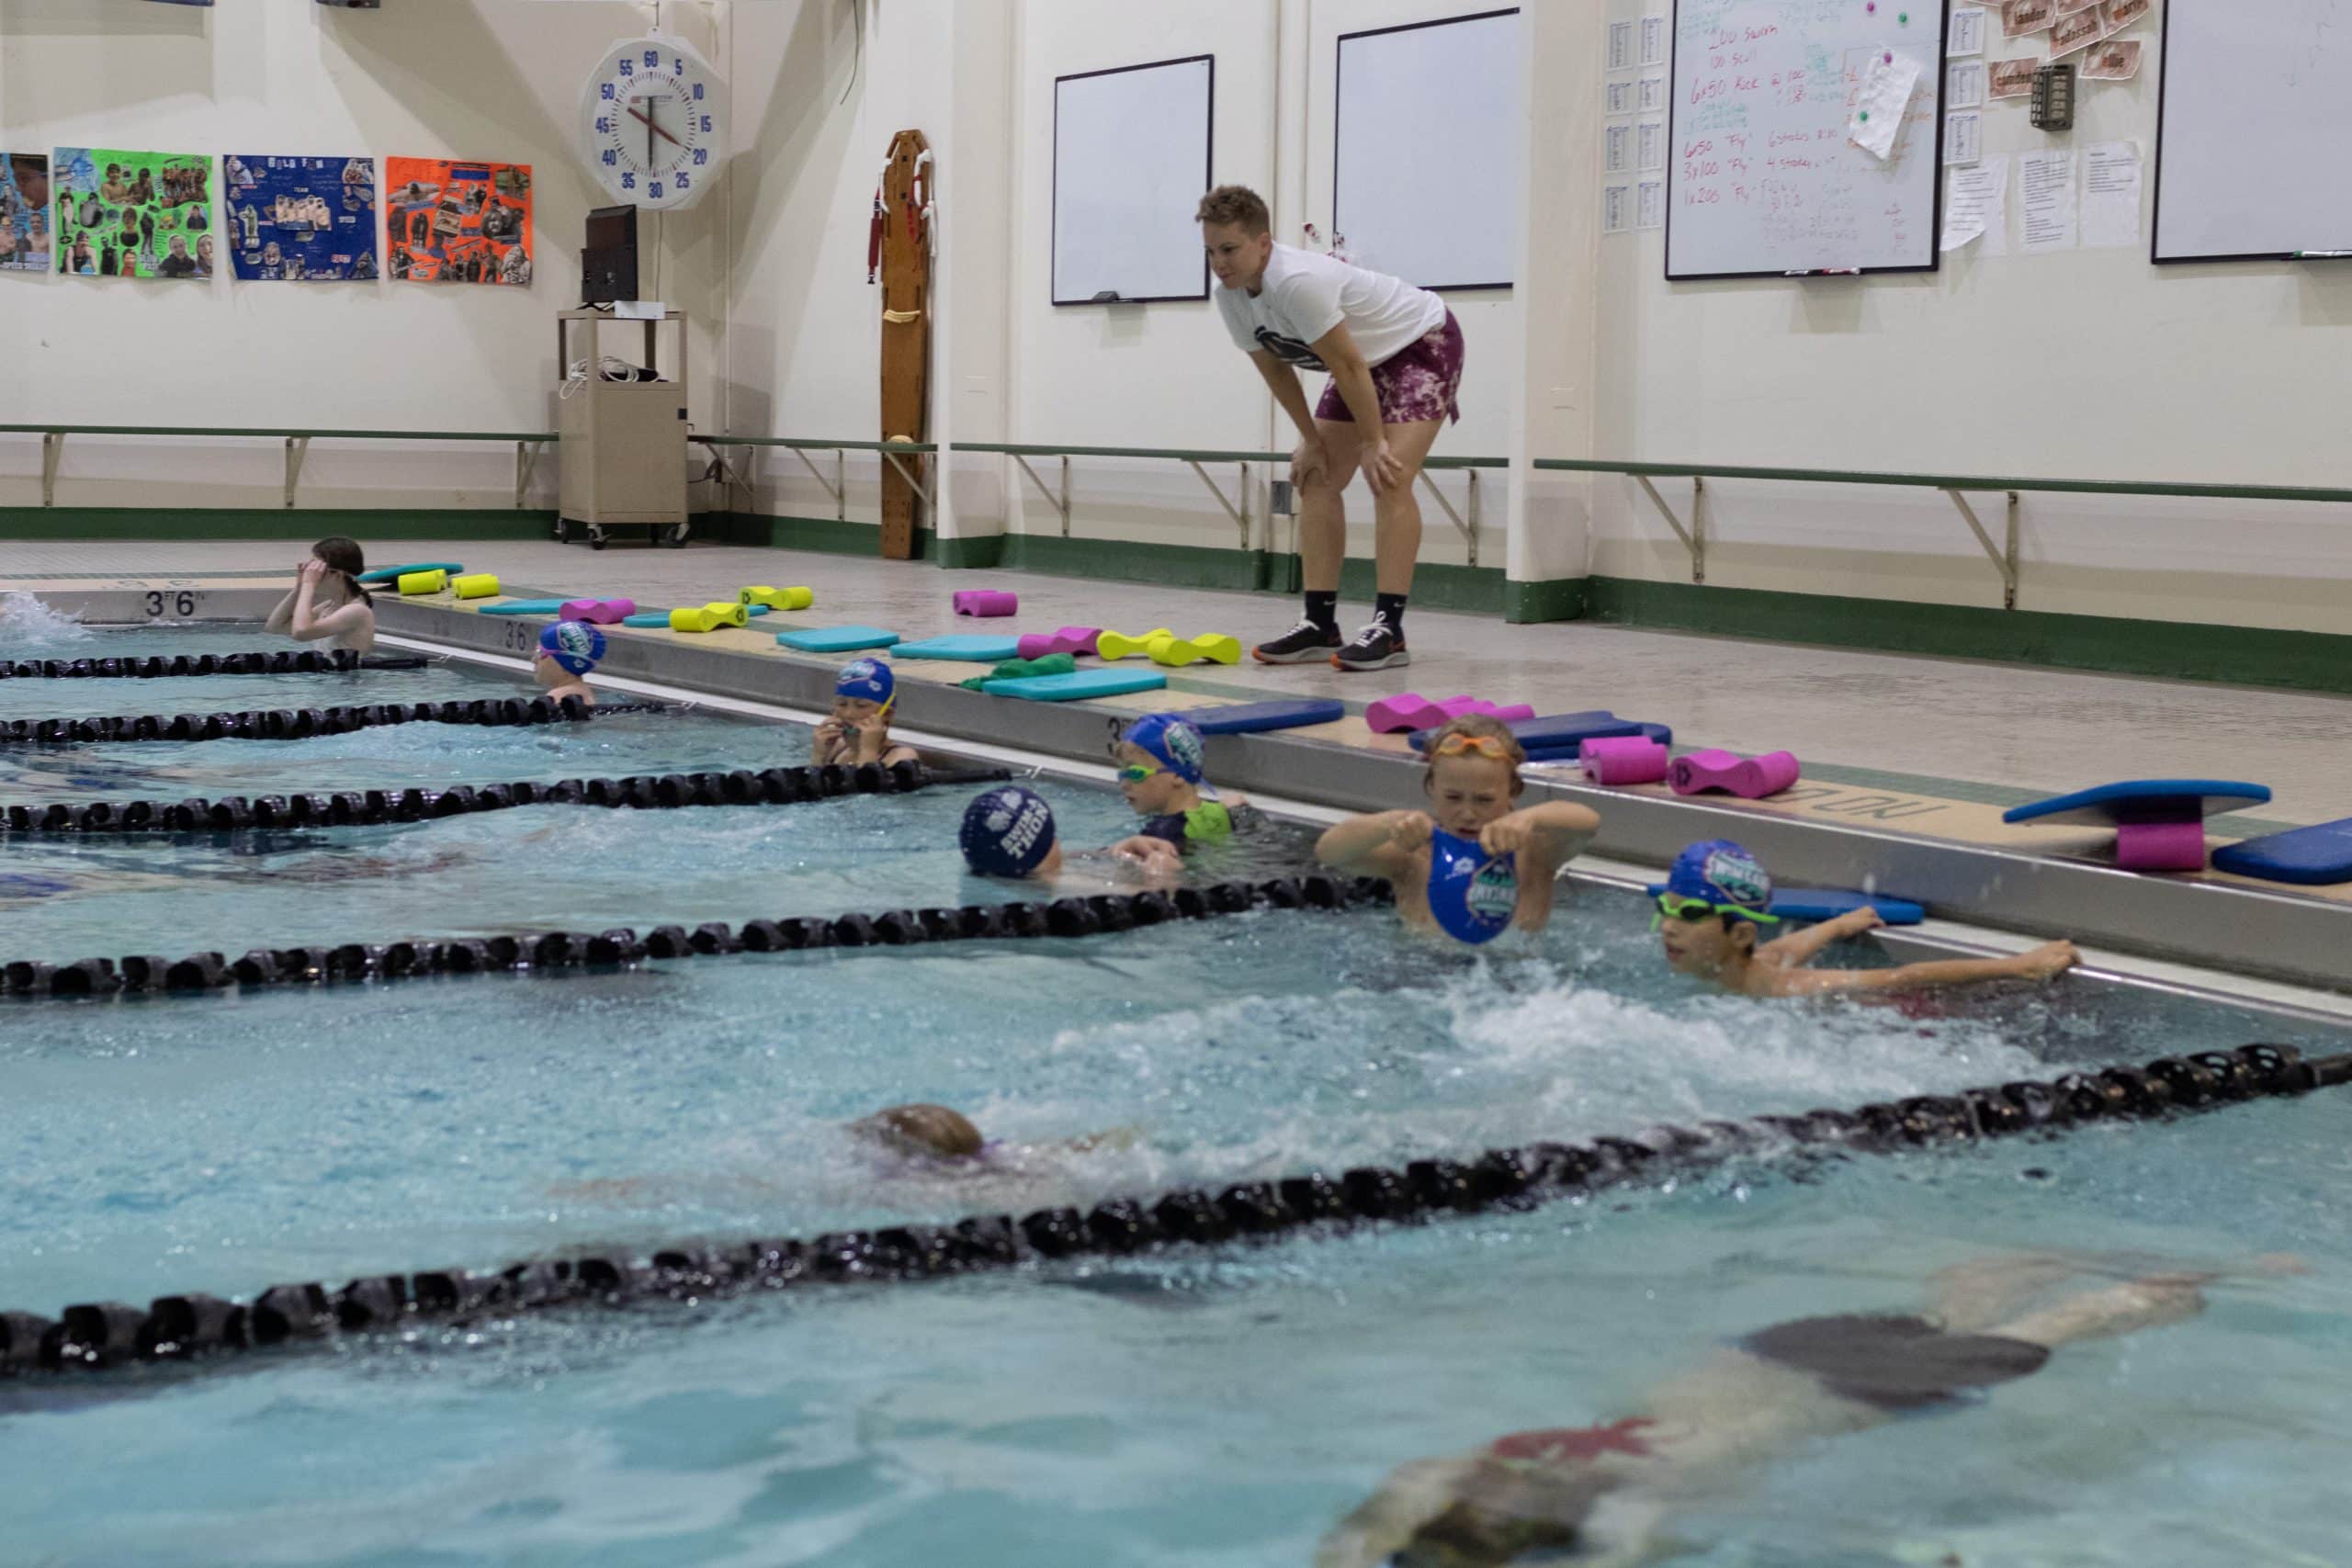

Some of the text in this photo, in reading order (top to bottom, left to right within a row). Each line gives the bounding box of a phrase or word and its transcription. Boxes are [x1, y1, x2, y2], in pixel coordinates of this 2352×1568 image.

[644, 51, 658, 67] 60
[619, 60, 632, 75] 55
[675, 59, 683, 75] 5
[601, 84, 614, 100] 50
[693, 84, 704, 100] 10
[595, 118, 609, 133] 45
[700, 116, 712, 132] 15
[603, 150, 616, 165] 40
[693, 149, 707, 164] 20
[622, 173, 635, 188] 35
[676, 173, 689, 188] 25
[649, 183, 662, 197] 30
